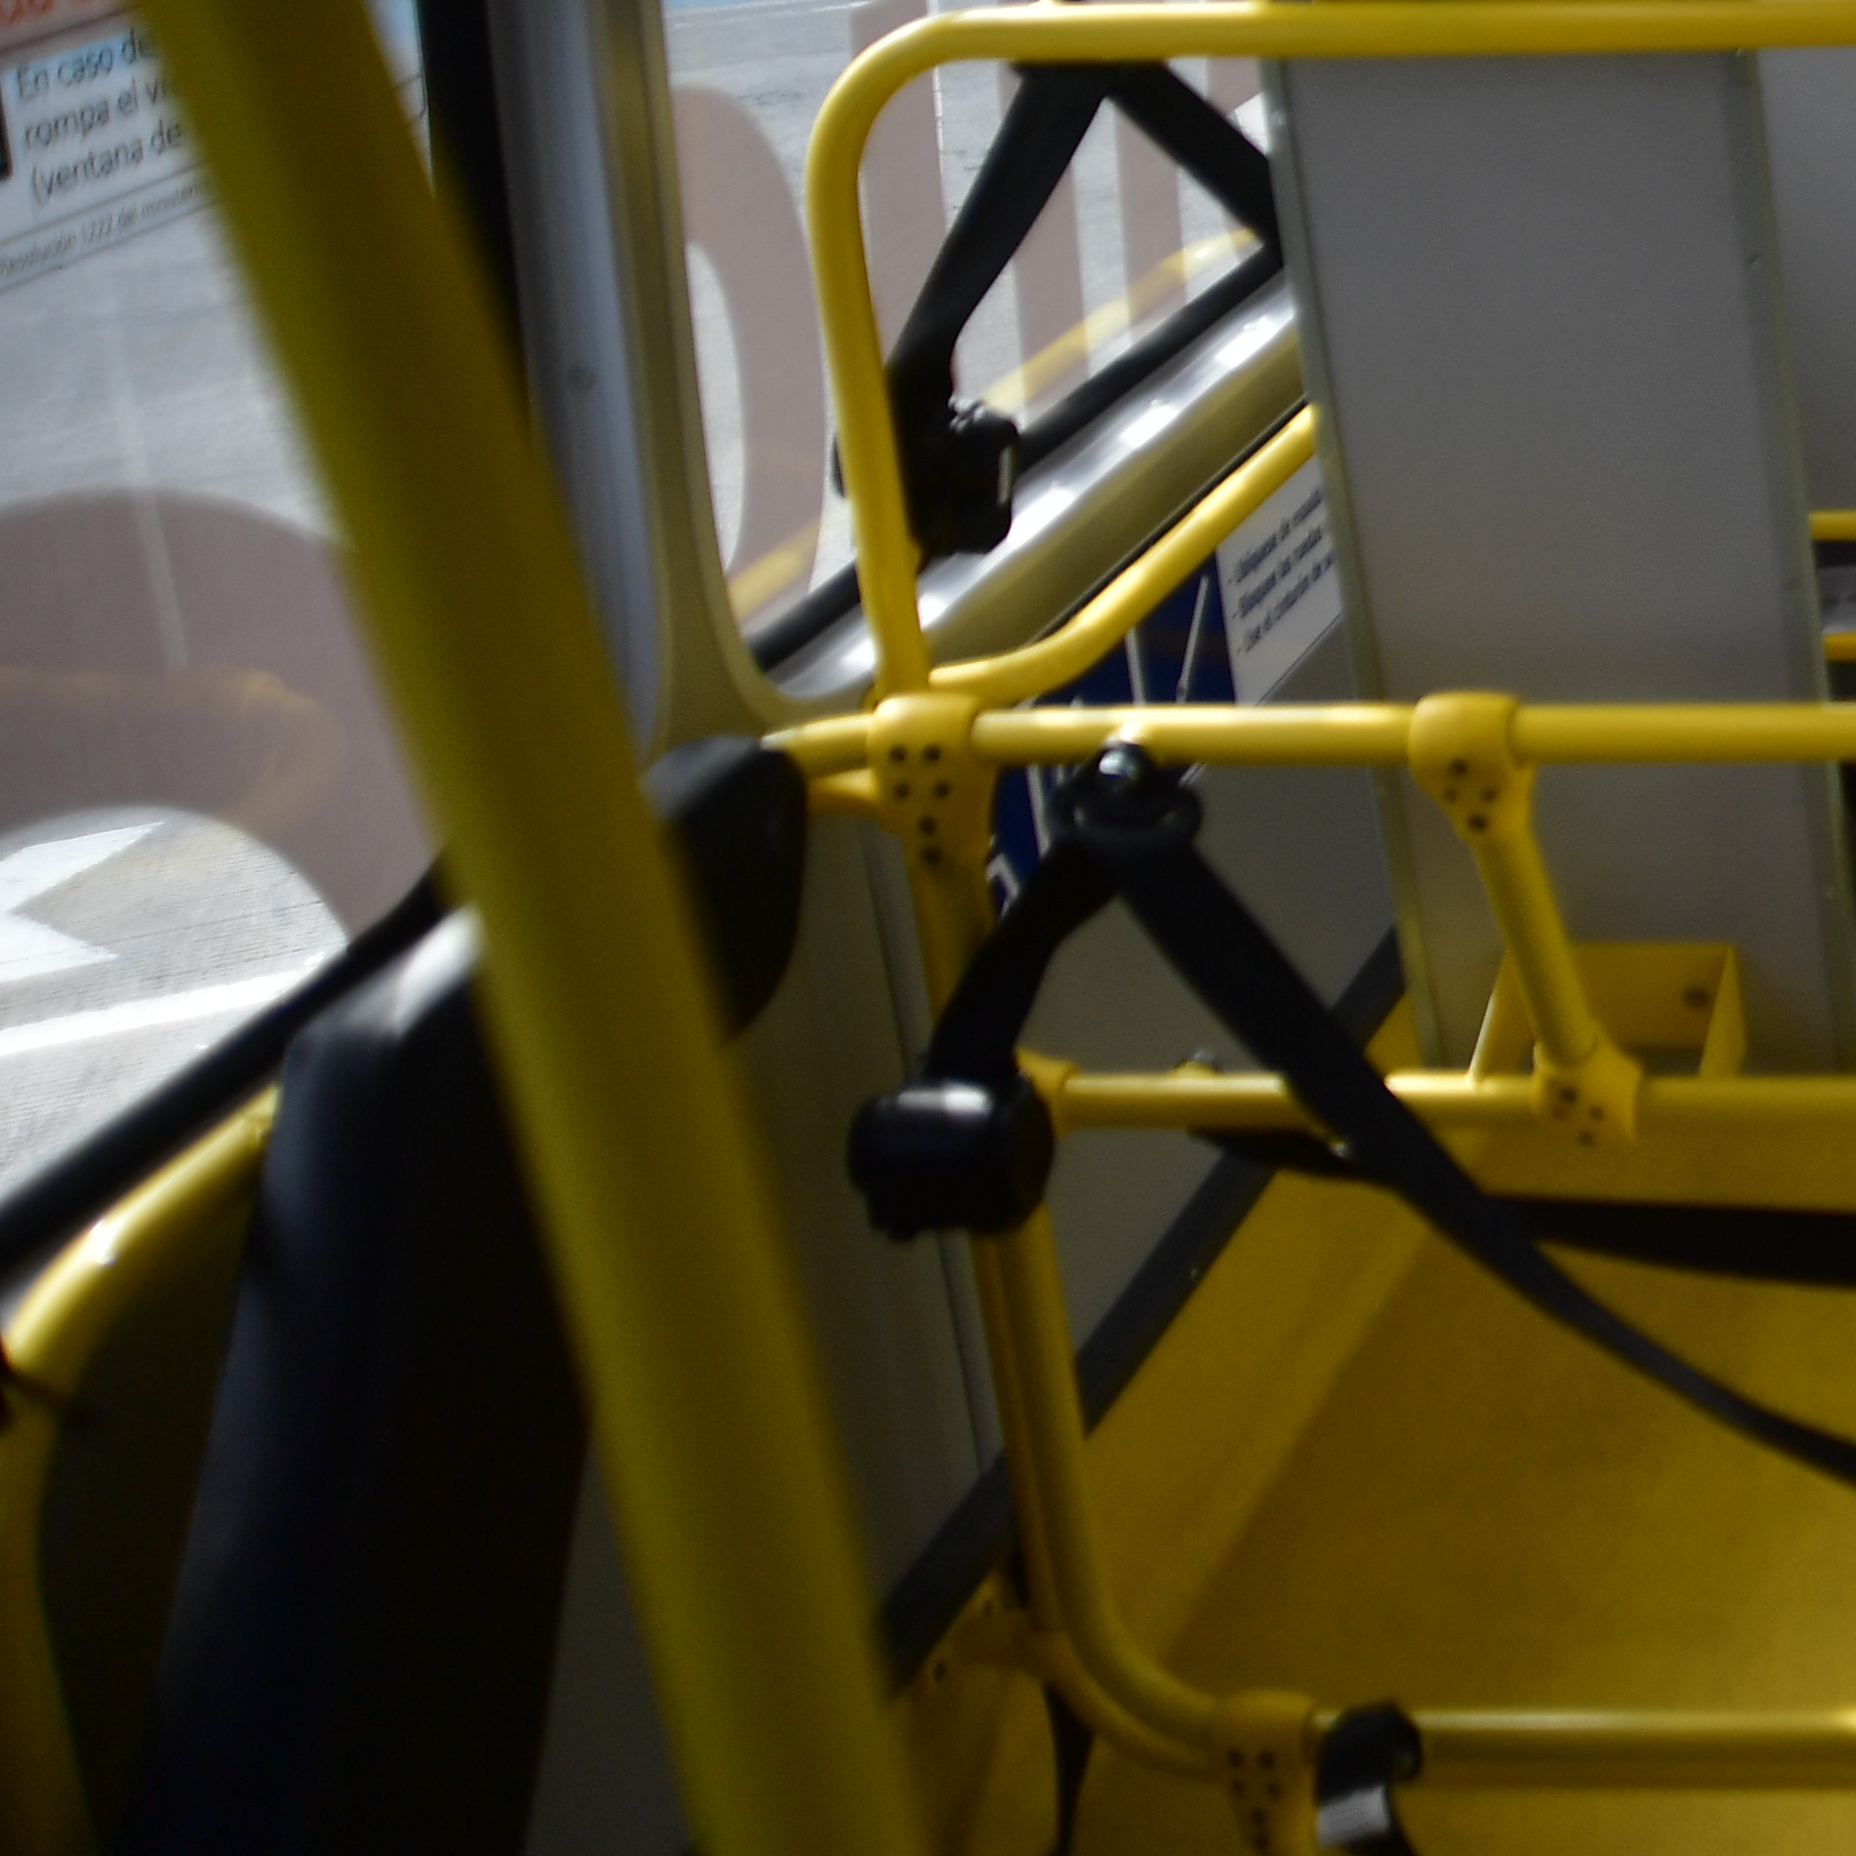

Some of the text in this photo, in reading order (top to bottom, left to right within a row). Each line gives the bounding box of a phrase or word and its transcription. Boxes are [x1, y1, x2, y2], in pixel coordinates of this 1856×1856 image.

[16, 64, 50, 98] En
[57, 49, 114, 88] caso
[24, 92, 111, 150] rompa
[117, 79, 139, 116] el
[31, 133, 145, 208] (ventana
